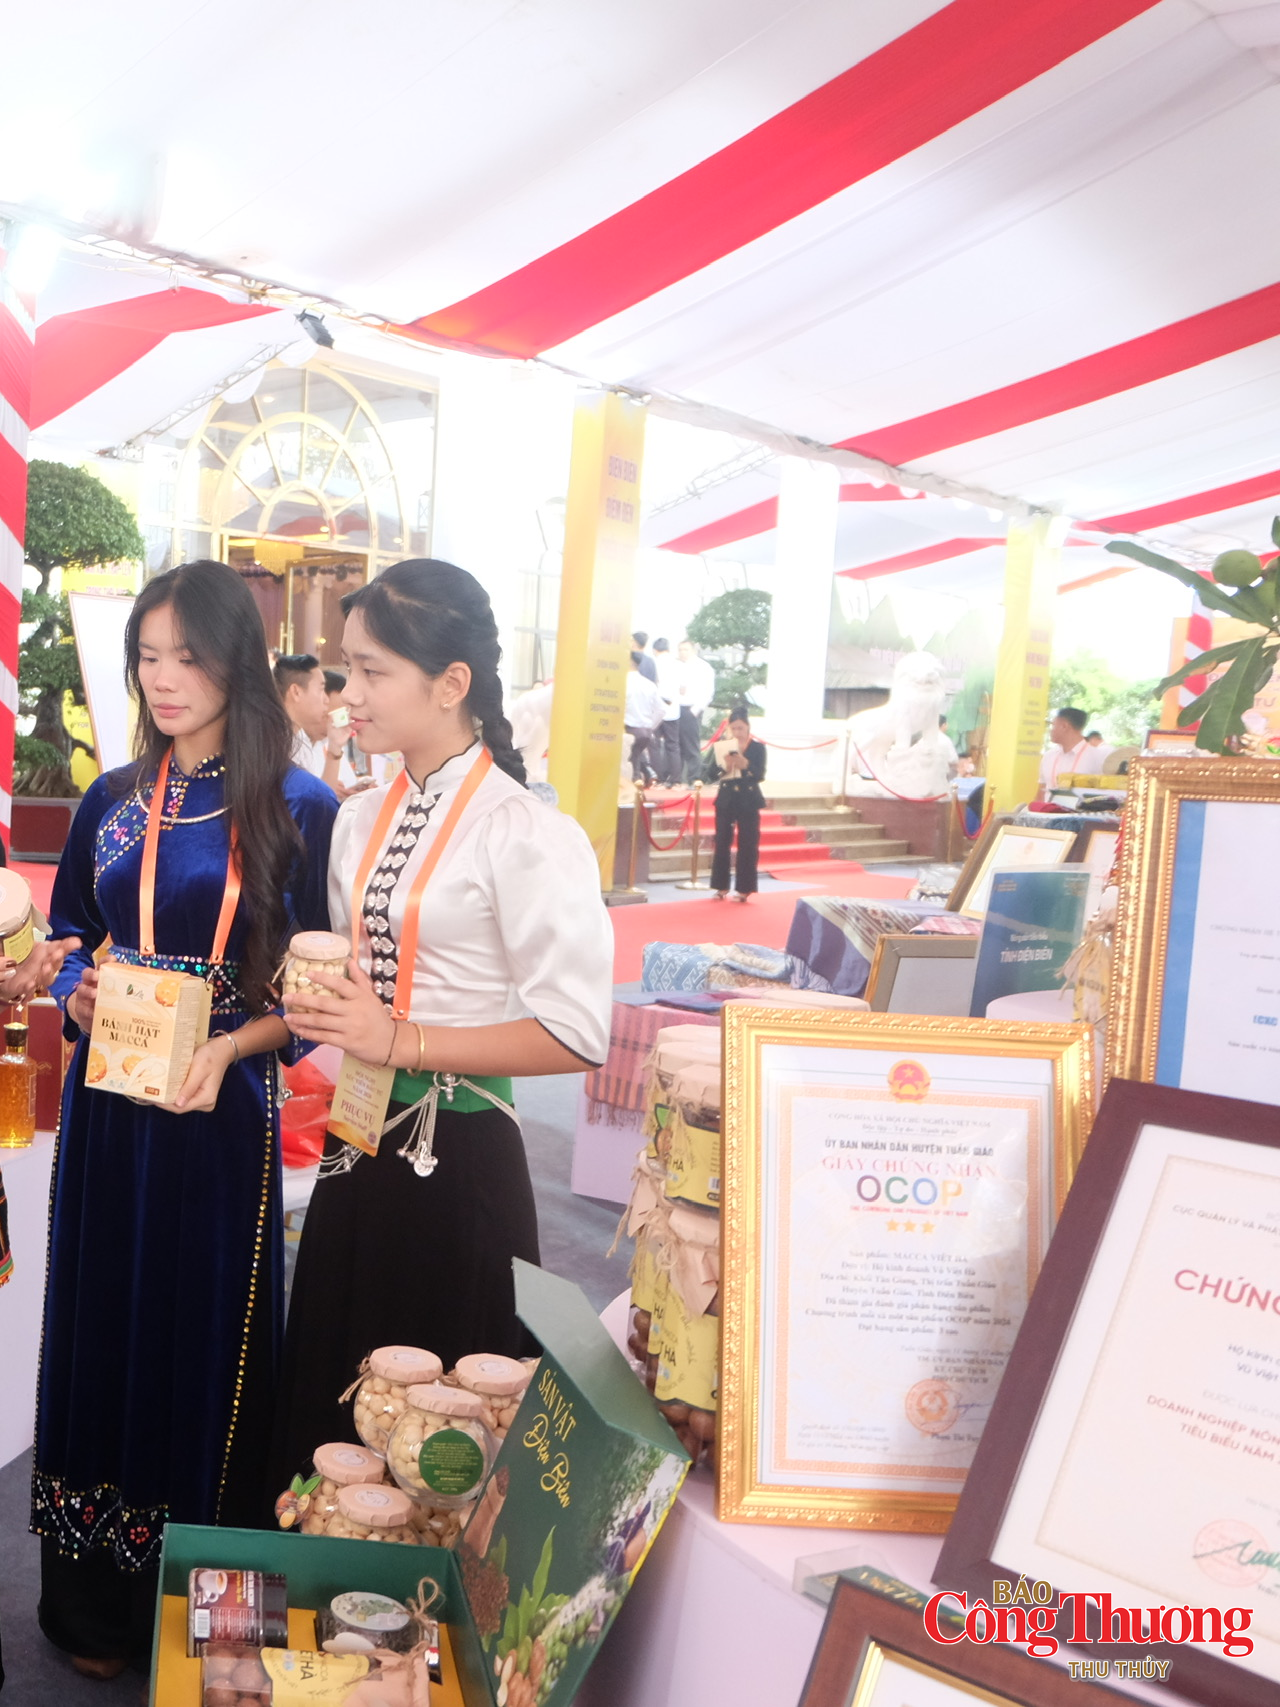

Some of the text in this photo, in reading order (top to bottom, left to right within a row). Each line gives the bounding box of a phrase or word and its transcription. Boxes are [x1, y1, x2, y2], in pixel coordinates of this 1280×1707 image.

[102, 1017, 132, 1033] BÁNH
[840, 1140, 858, 1149] BAN
[861, 1139, 886, 1151] NHÂN
[890, 1140, 909, 1152] DÂN
[912, 1142, 942, 1155] HUYỆN
[857, 1175, 963, 1207] OCOP
[538, 1368, 577, 1442] SẢN VẬT
[1147, 1394, 1194, 1417] DOANH
[1197, 1411, 1247, 1433] NGHIỆP
[523, 1413, 550, 1464] Điện
[1180, 1422, 1274, 1461] TIÊU BIỂU NĂM
[540, 1452, 571, 1508] Biên
